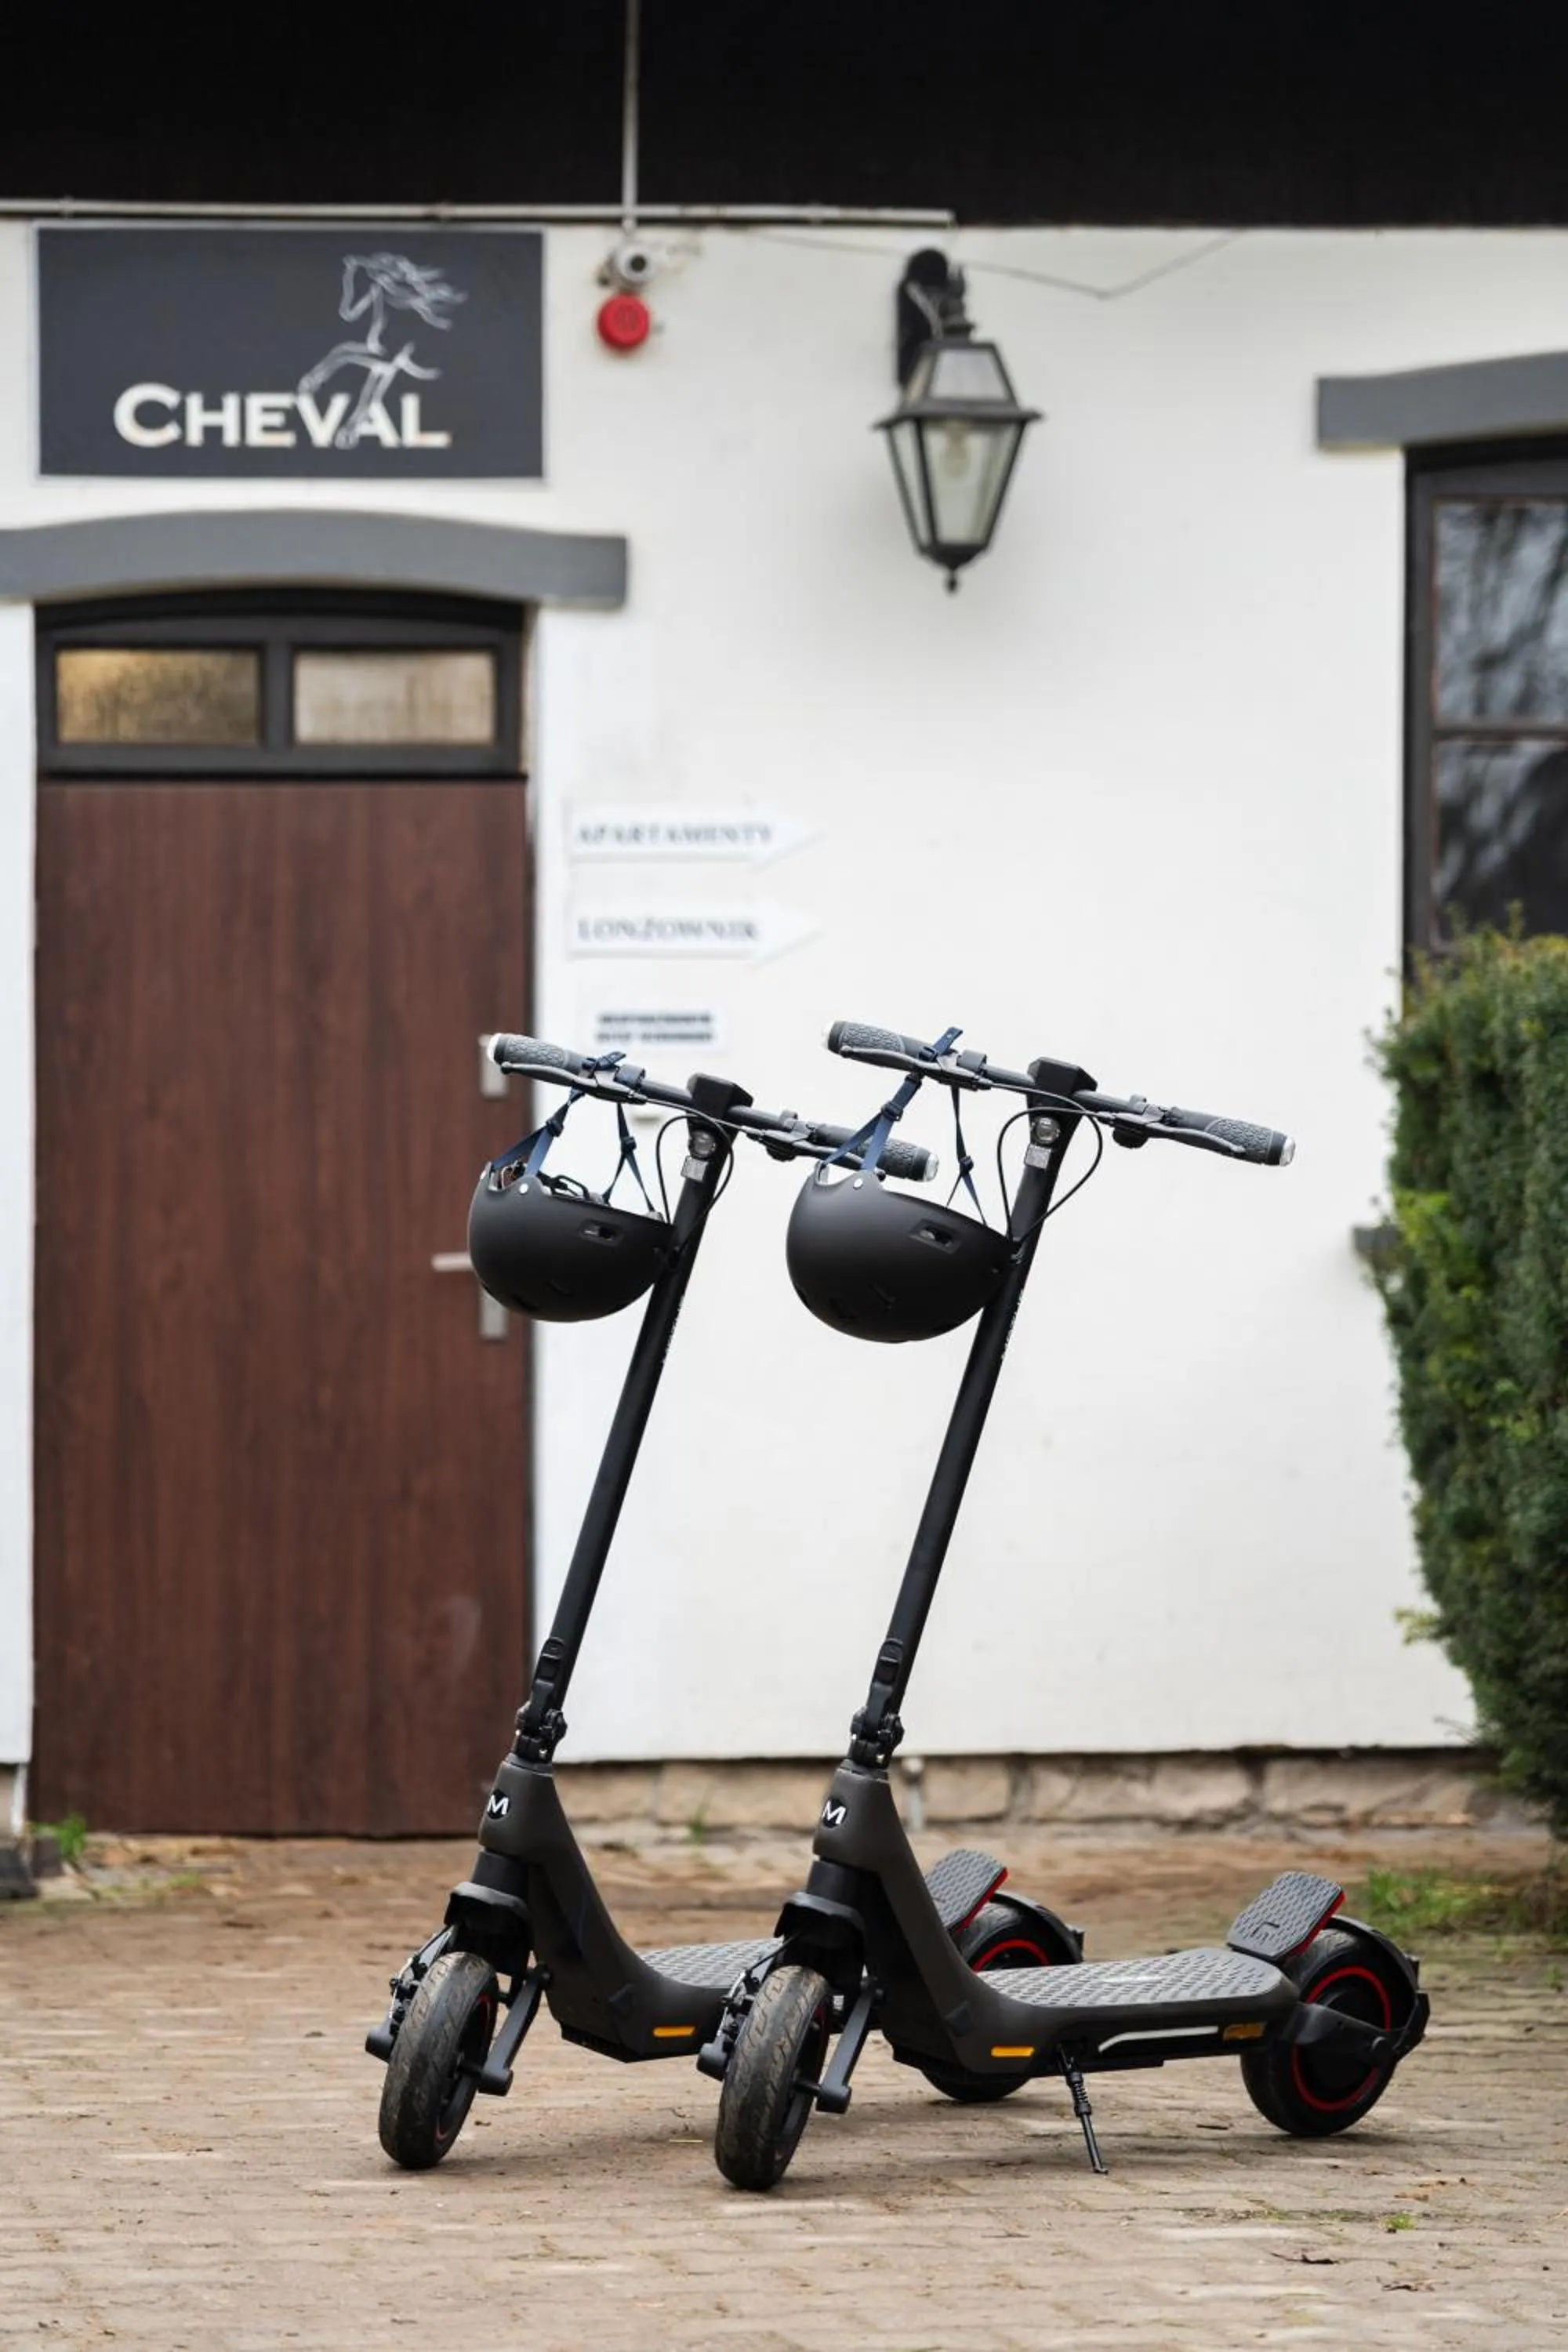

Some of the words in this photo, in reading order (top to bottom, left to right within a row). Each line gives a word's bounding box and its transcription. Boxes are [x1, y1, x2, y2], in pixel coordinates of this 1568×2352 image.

[114, 383, 452, 448] CHEVAL
[486, 1794, 509, 1815] M
[821, 1799, 847, 1824] M
